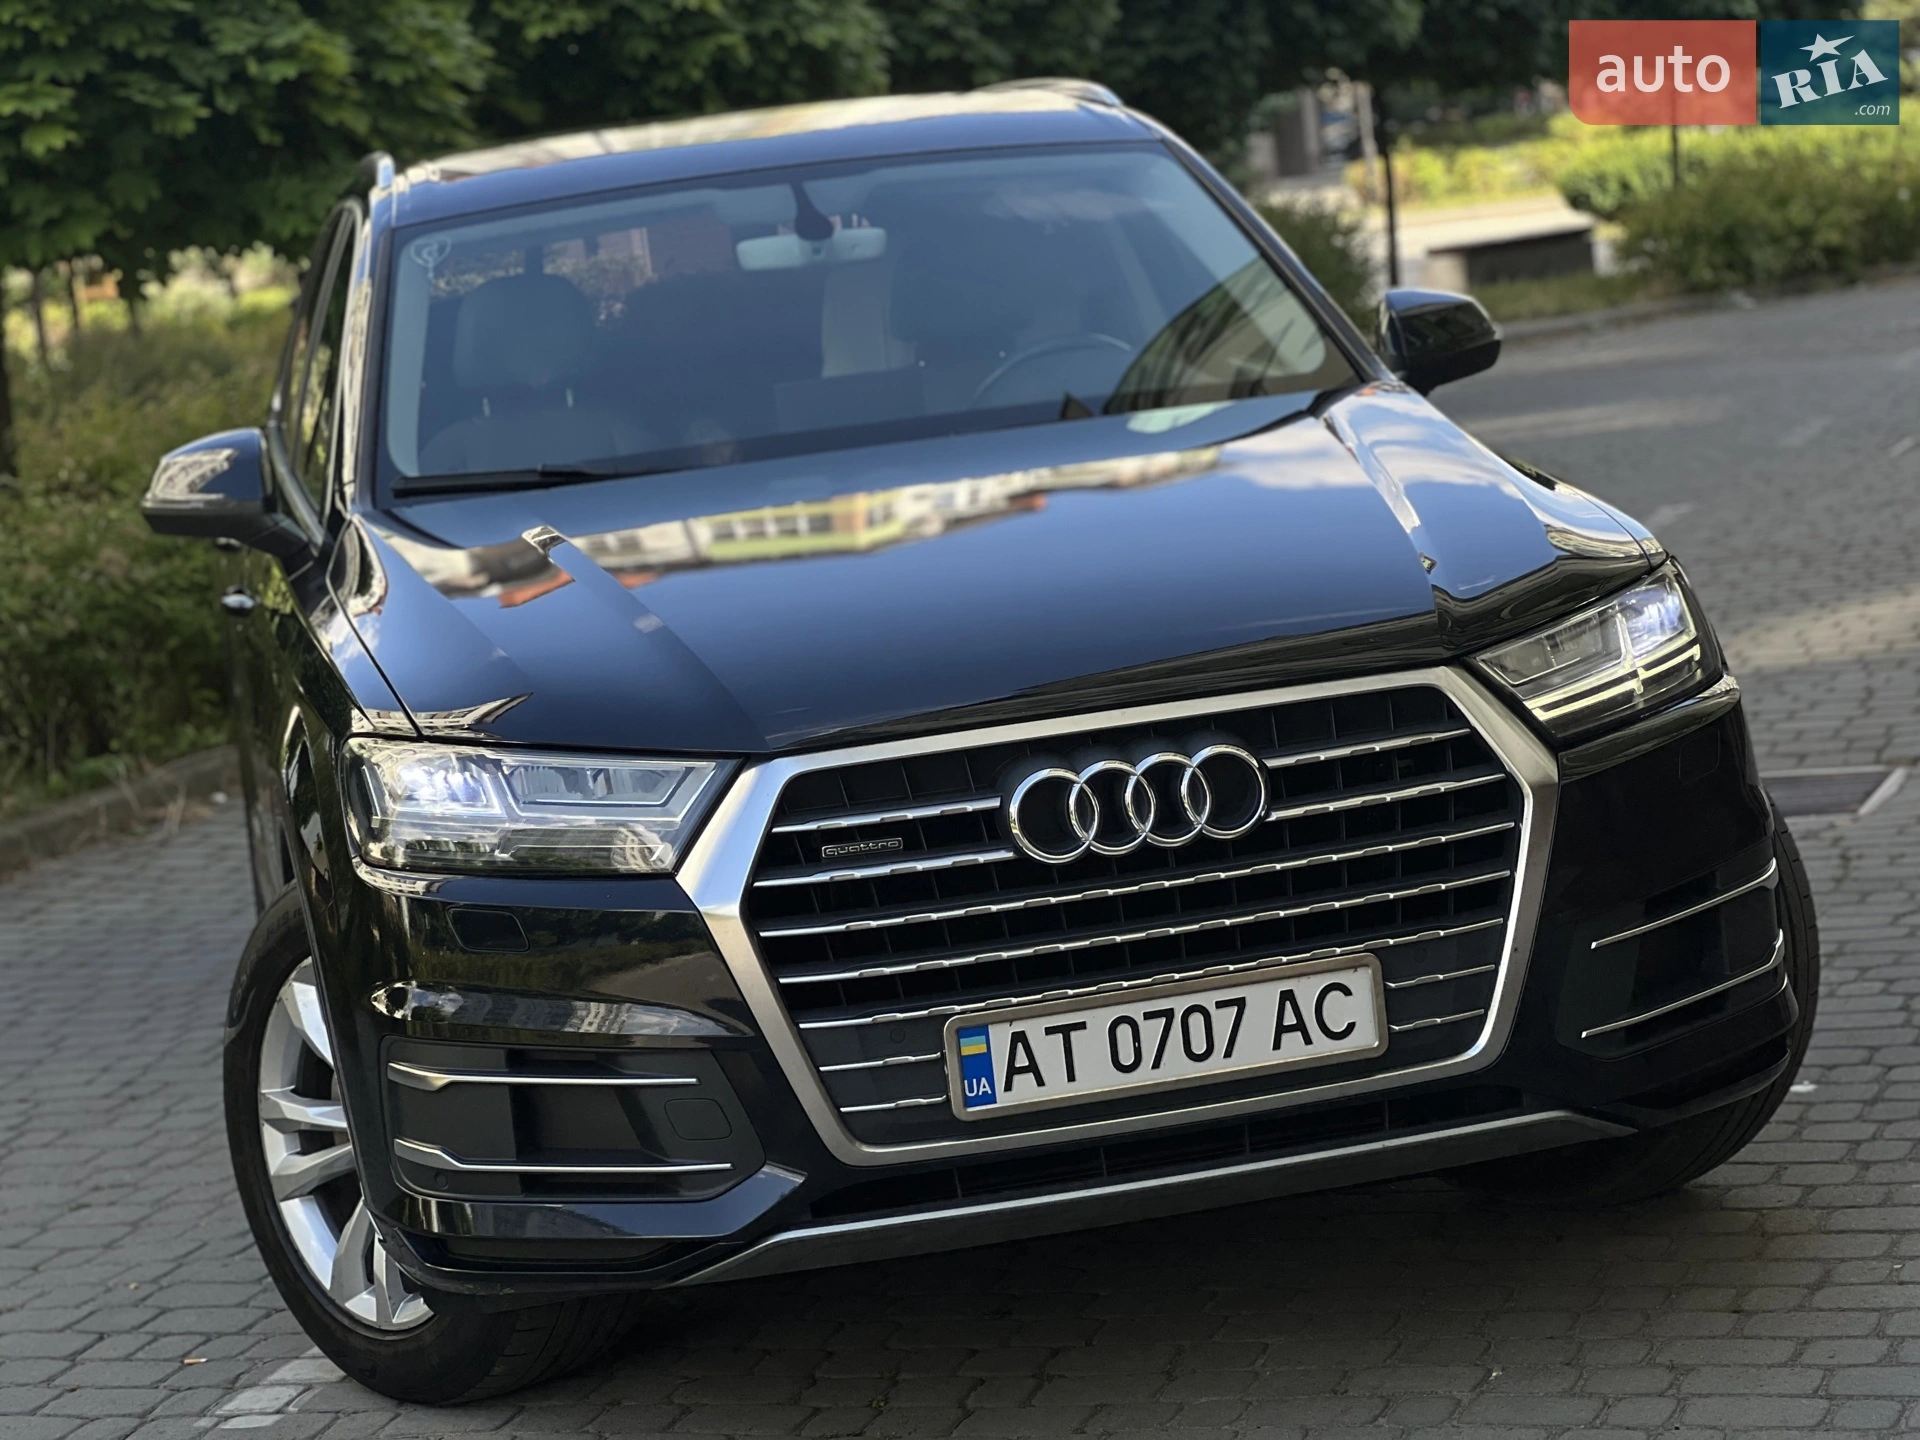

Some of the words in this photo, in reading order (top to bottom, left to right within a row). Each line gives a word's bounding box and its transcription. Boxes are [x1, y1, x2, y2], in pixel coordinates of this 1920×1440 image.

[825, 840, 900, 856] quattro
[1003, 1020, 1087, 1093] AT
[1107, 996, 1247, 1074] 0707
[1271, 982, 1357, 1051] AC
[963, 1076, 992, 1097] UA
